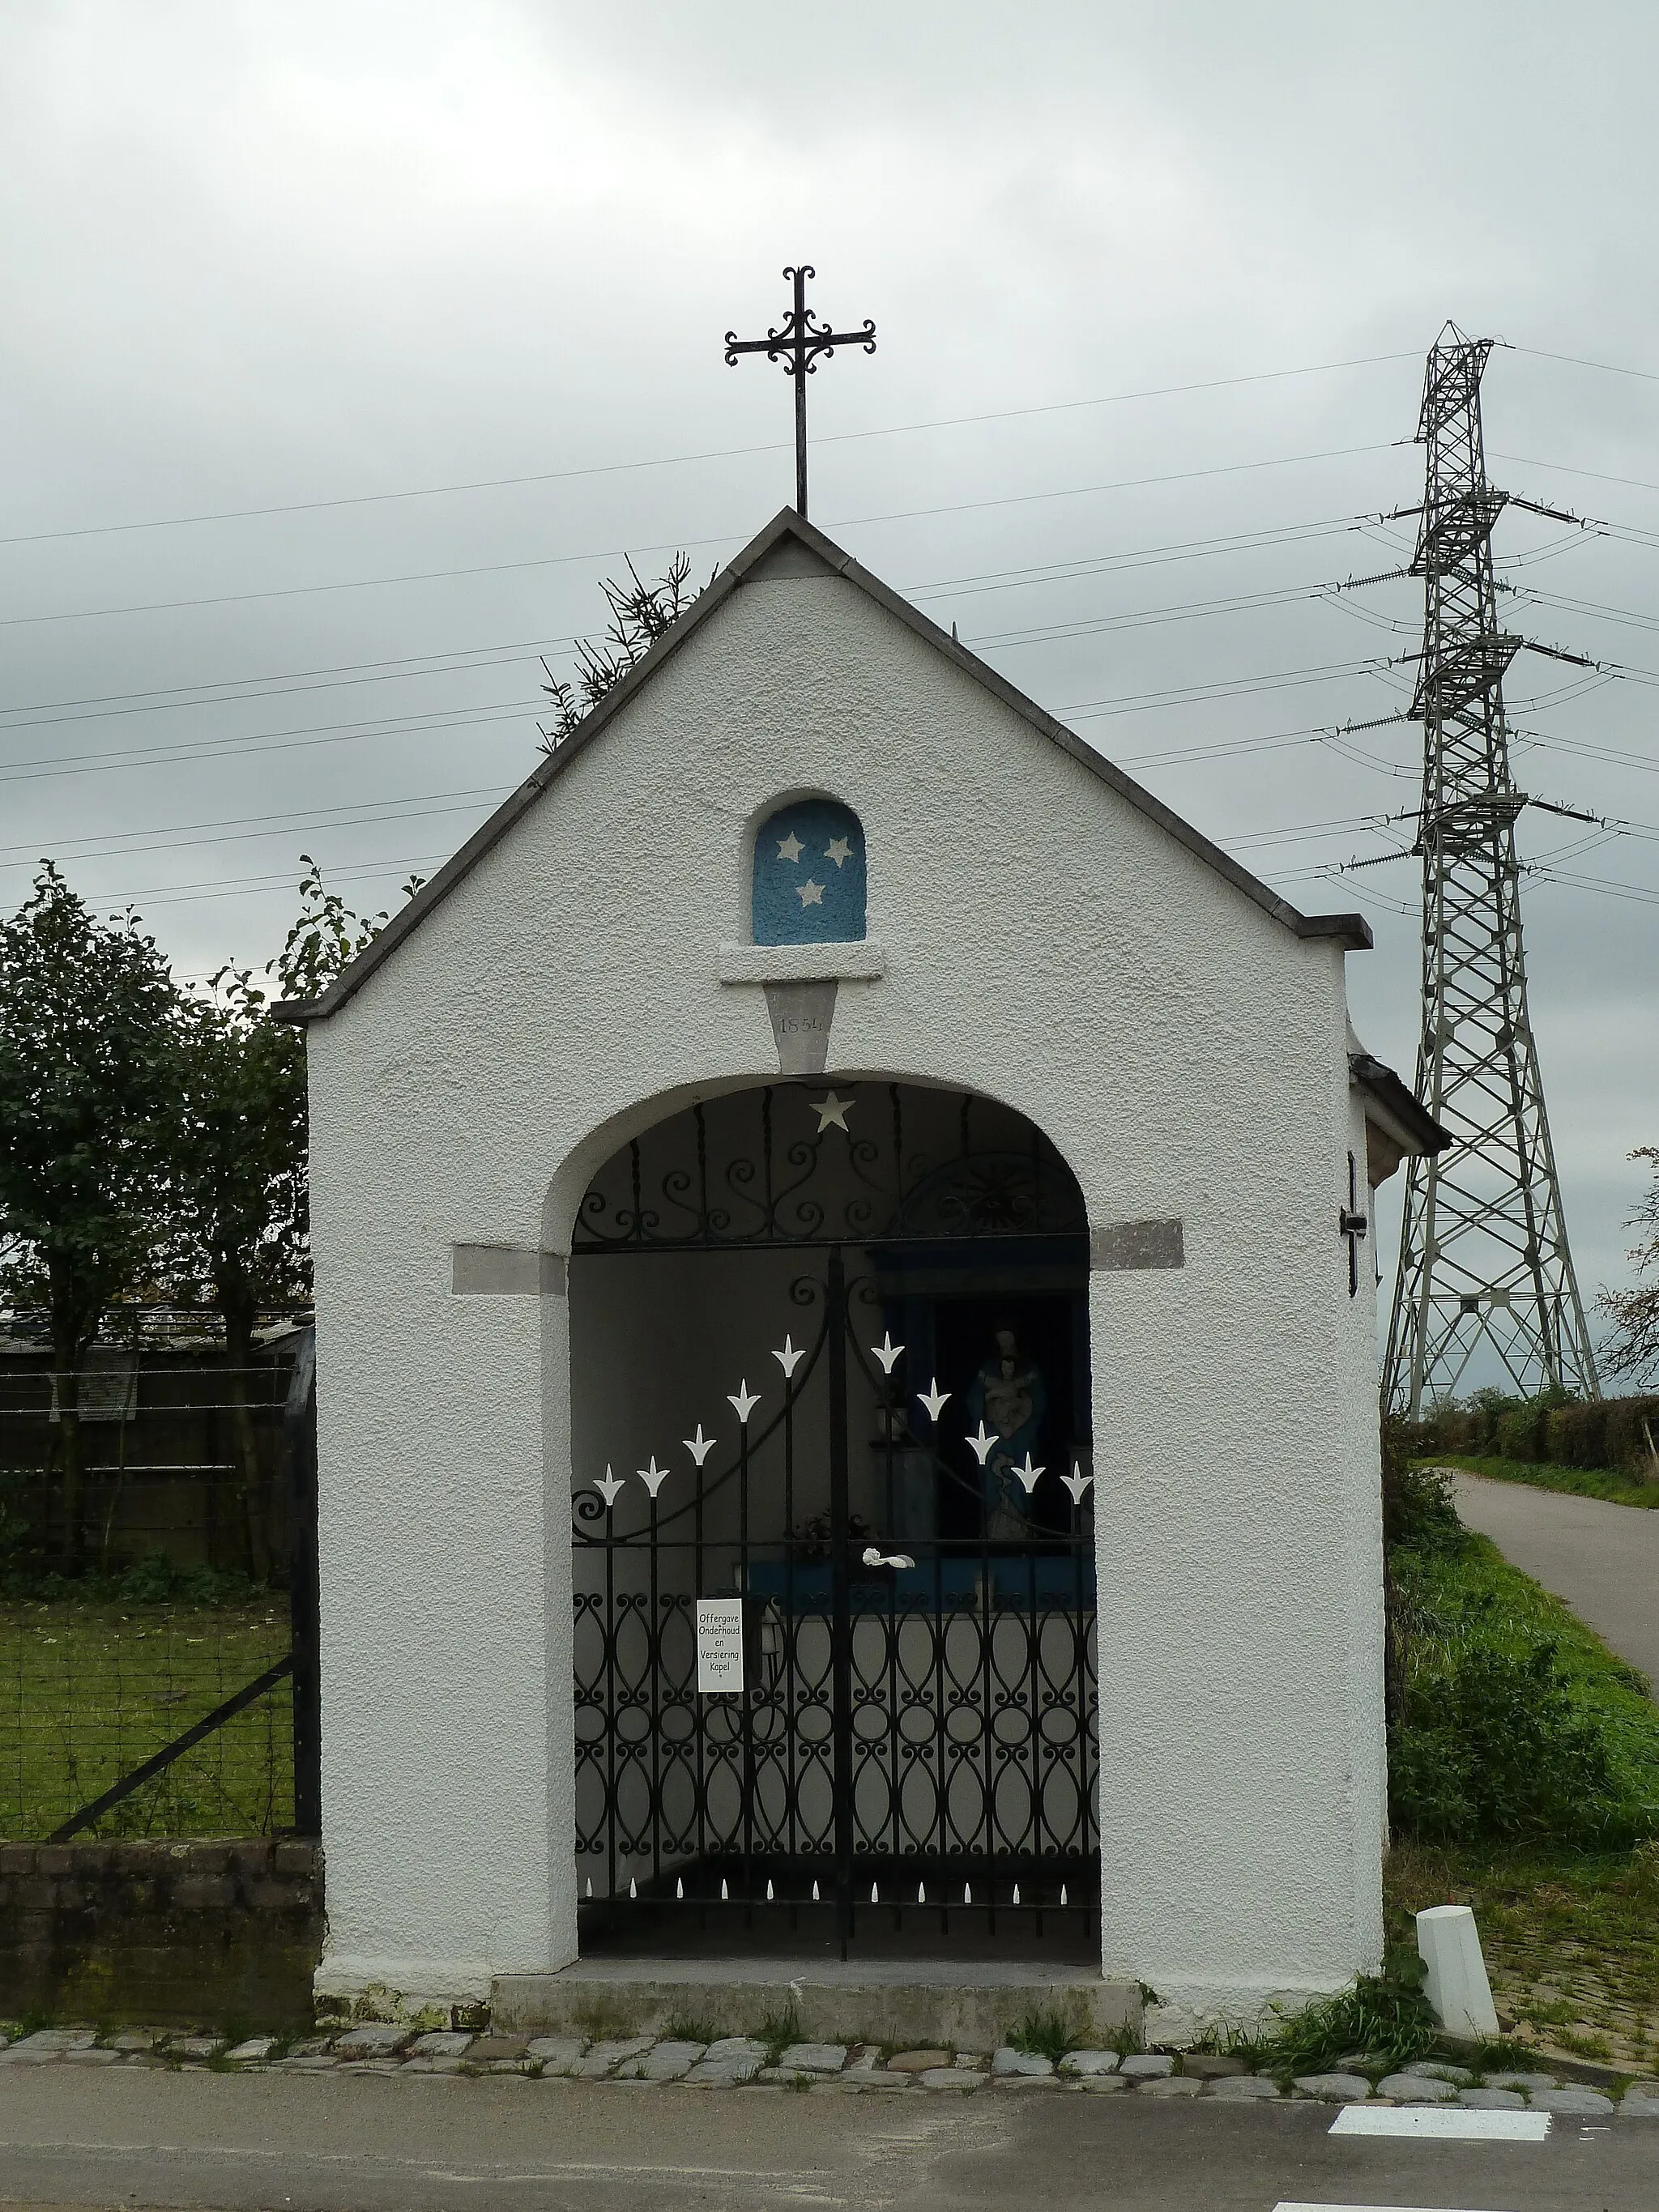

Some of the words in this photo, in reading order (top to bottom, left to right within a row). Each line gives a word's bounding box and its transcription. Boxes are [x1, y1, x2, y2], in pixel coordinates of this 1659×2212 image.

[699, 1613, 739, 1625] Offergave
[699, 1626, 740, 1634] Onderhoud
[701, 1650, 739, 1661] Versiering
[710, 1662, 730, 1673] Kapel
